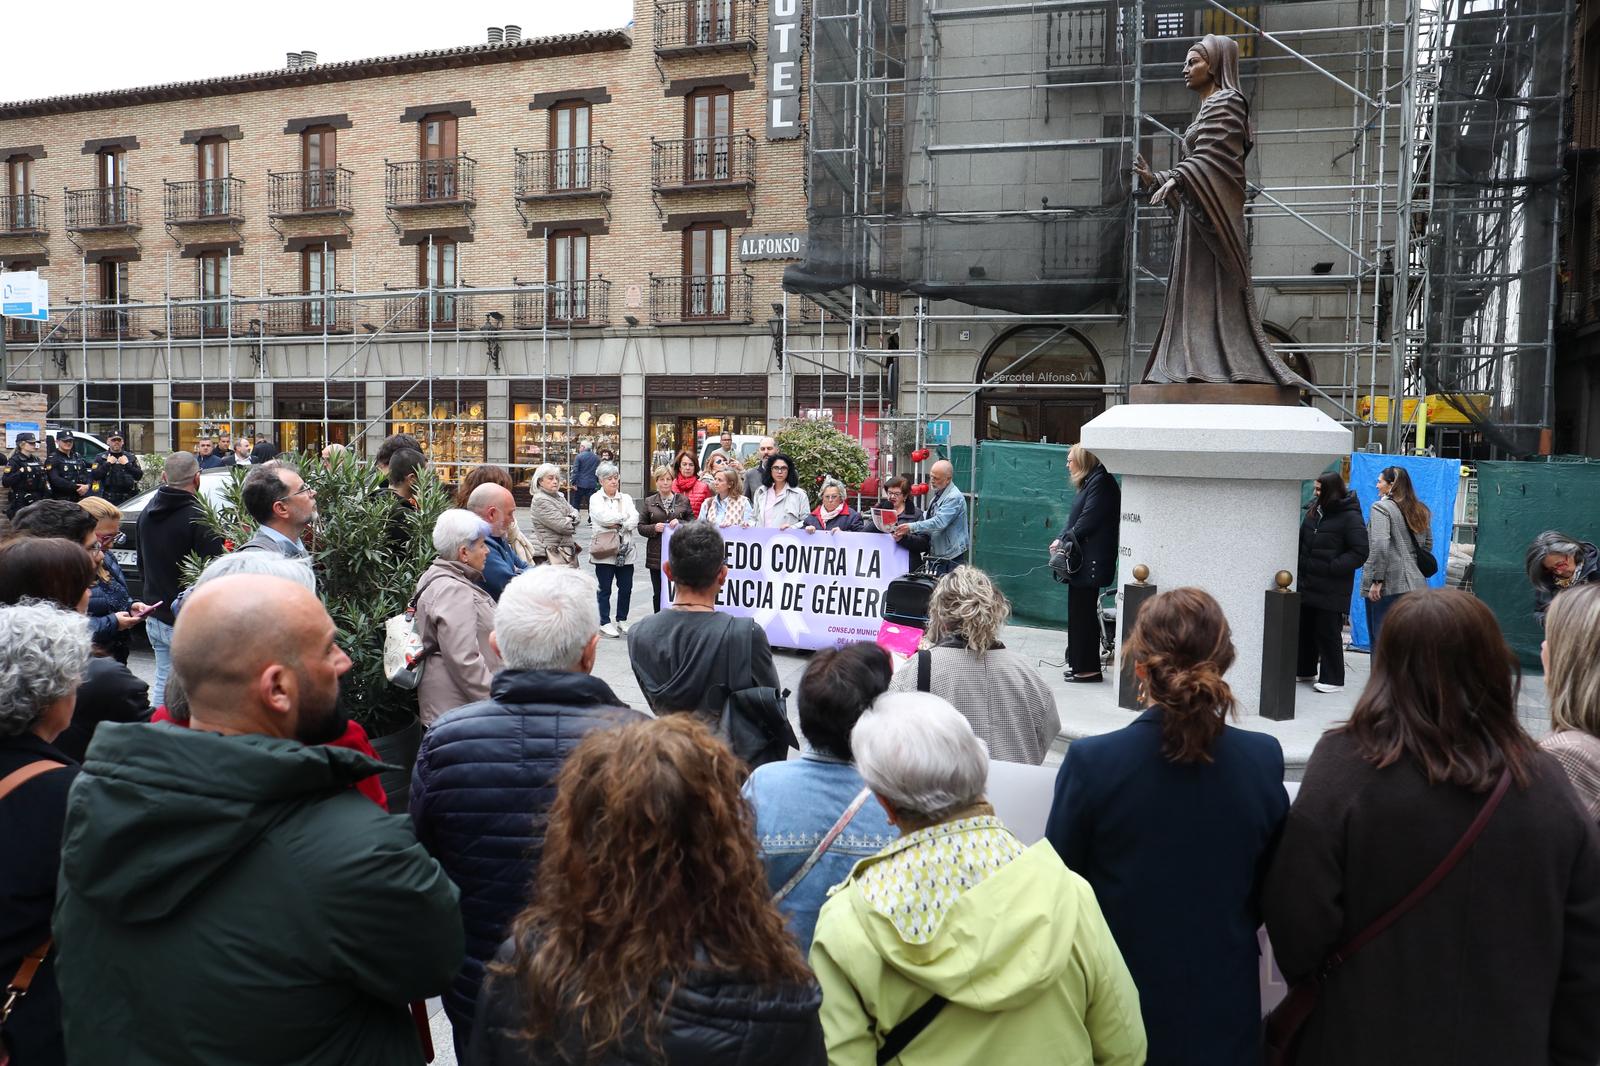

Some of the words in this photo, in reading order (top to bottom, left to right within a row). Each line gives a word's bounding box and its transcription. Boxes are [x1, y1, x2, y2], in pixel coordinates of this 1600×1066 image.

[993, 371, 1034, 382] Sercotel
[1037, 371, 1077, 382] Alfonso
[724, 541, 763, 571] EDO
[771, 543, 847, 576] CONTRA
[855, 548, 881, 579] LA
[780, 582, 806, 612] DE
[827, 625, 856, 635] CONSEJO
